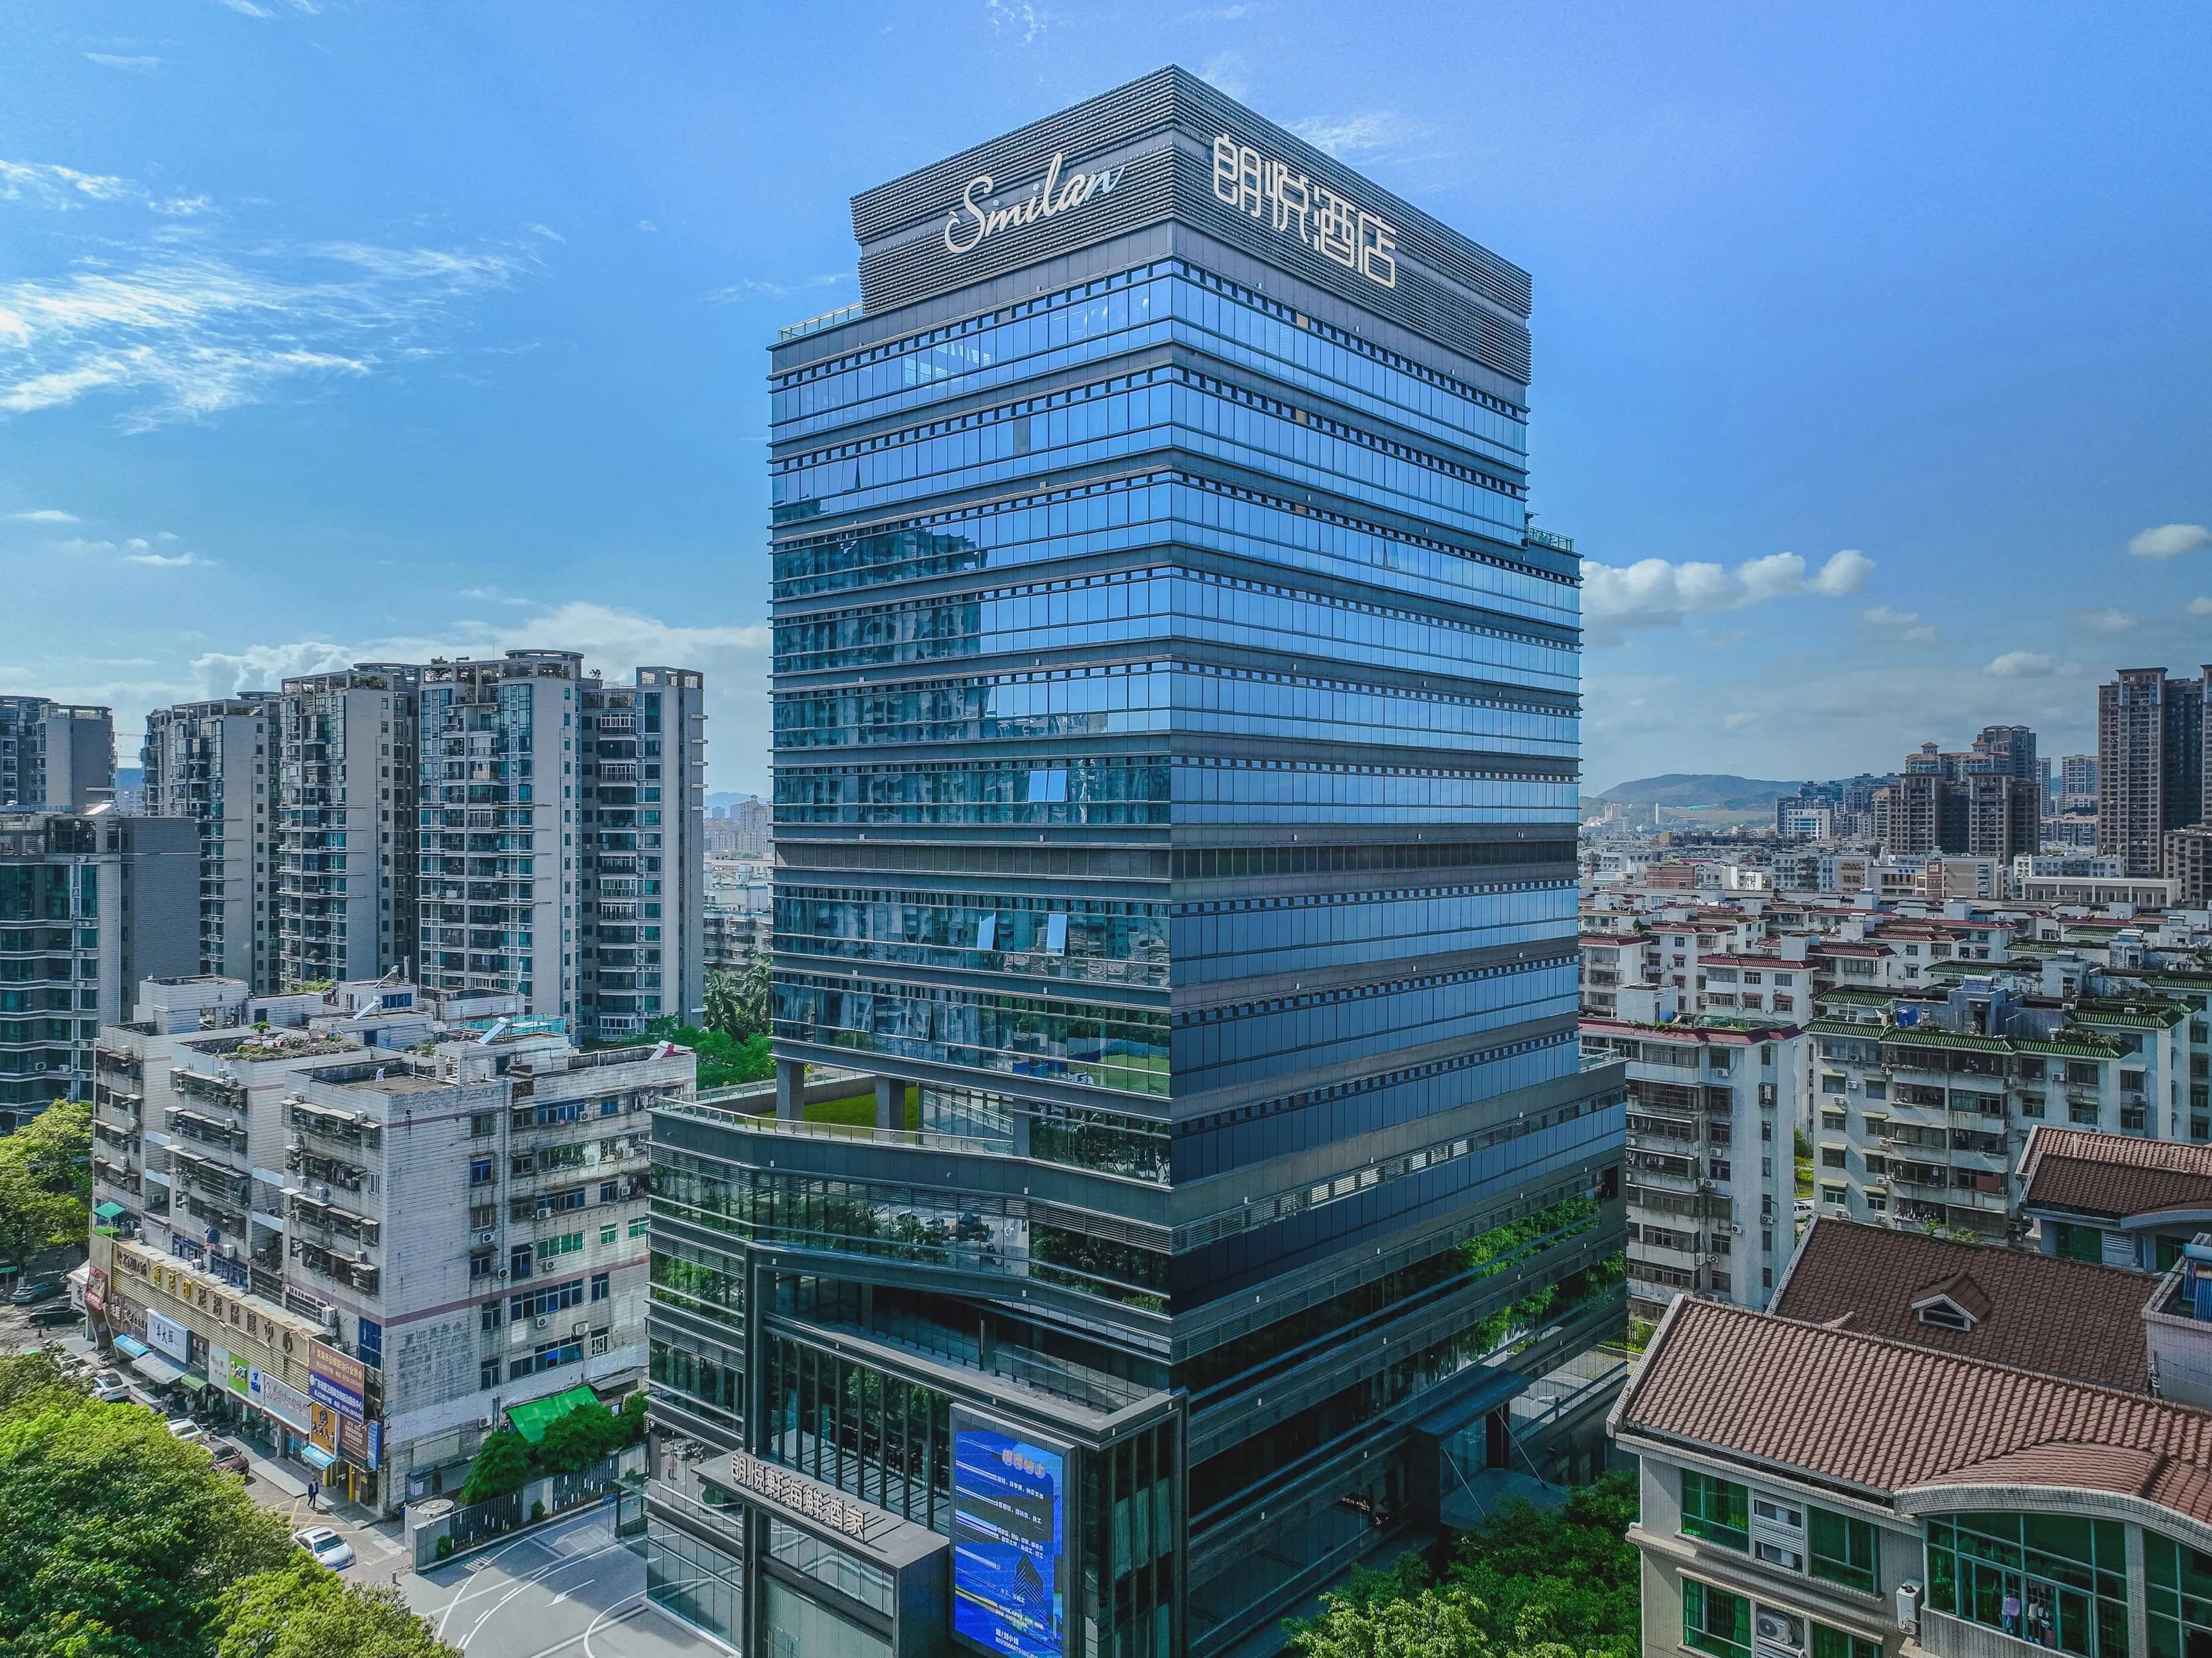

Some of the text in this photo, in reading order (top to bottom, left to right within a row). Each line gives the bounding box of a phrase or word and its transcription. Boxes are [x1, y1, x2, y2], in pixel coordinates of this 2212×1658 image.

[944, 153, 1126, 255] Smilan
[1213, 133, 1396, 288] 朗悦酒店
